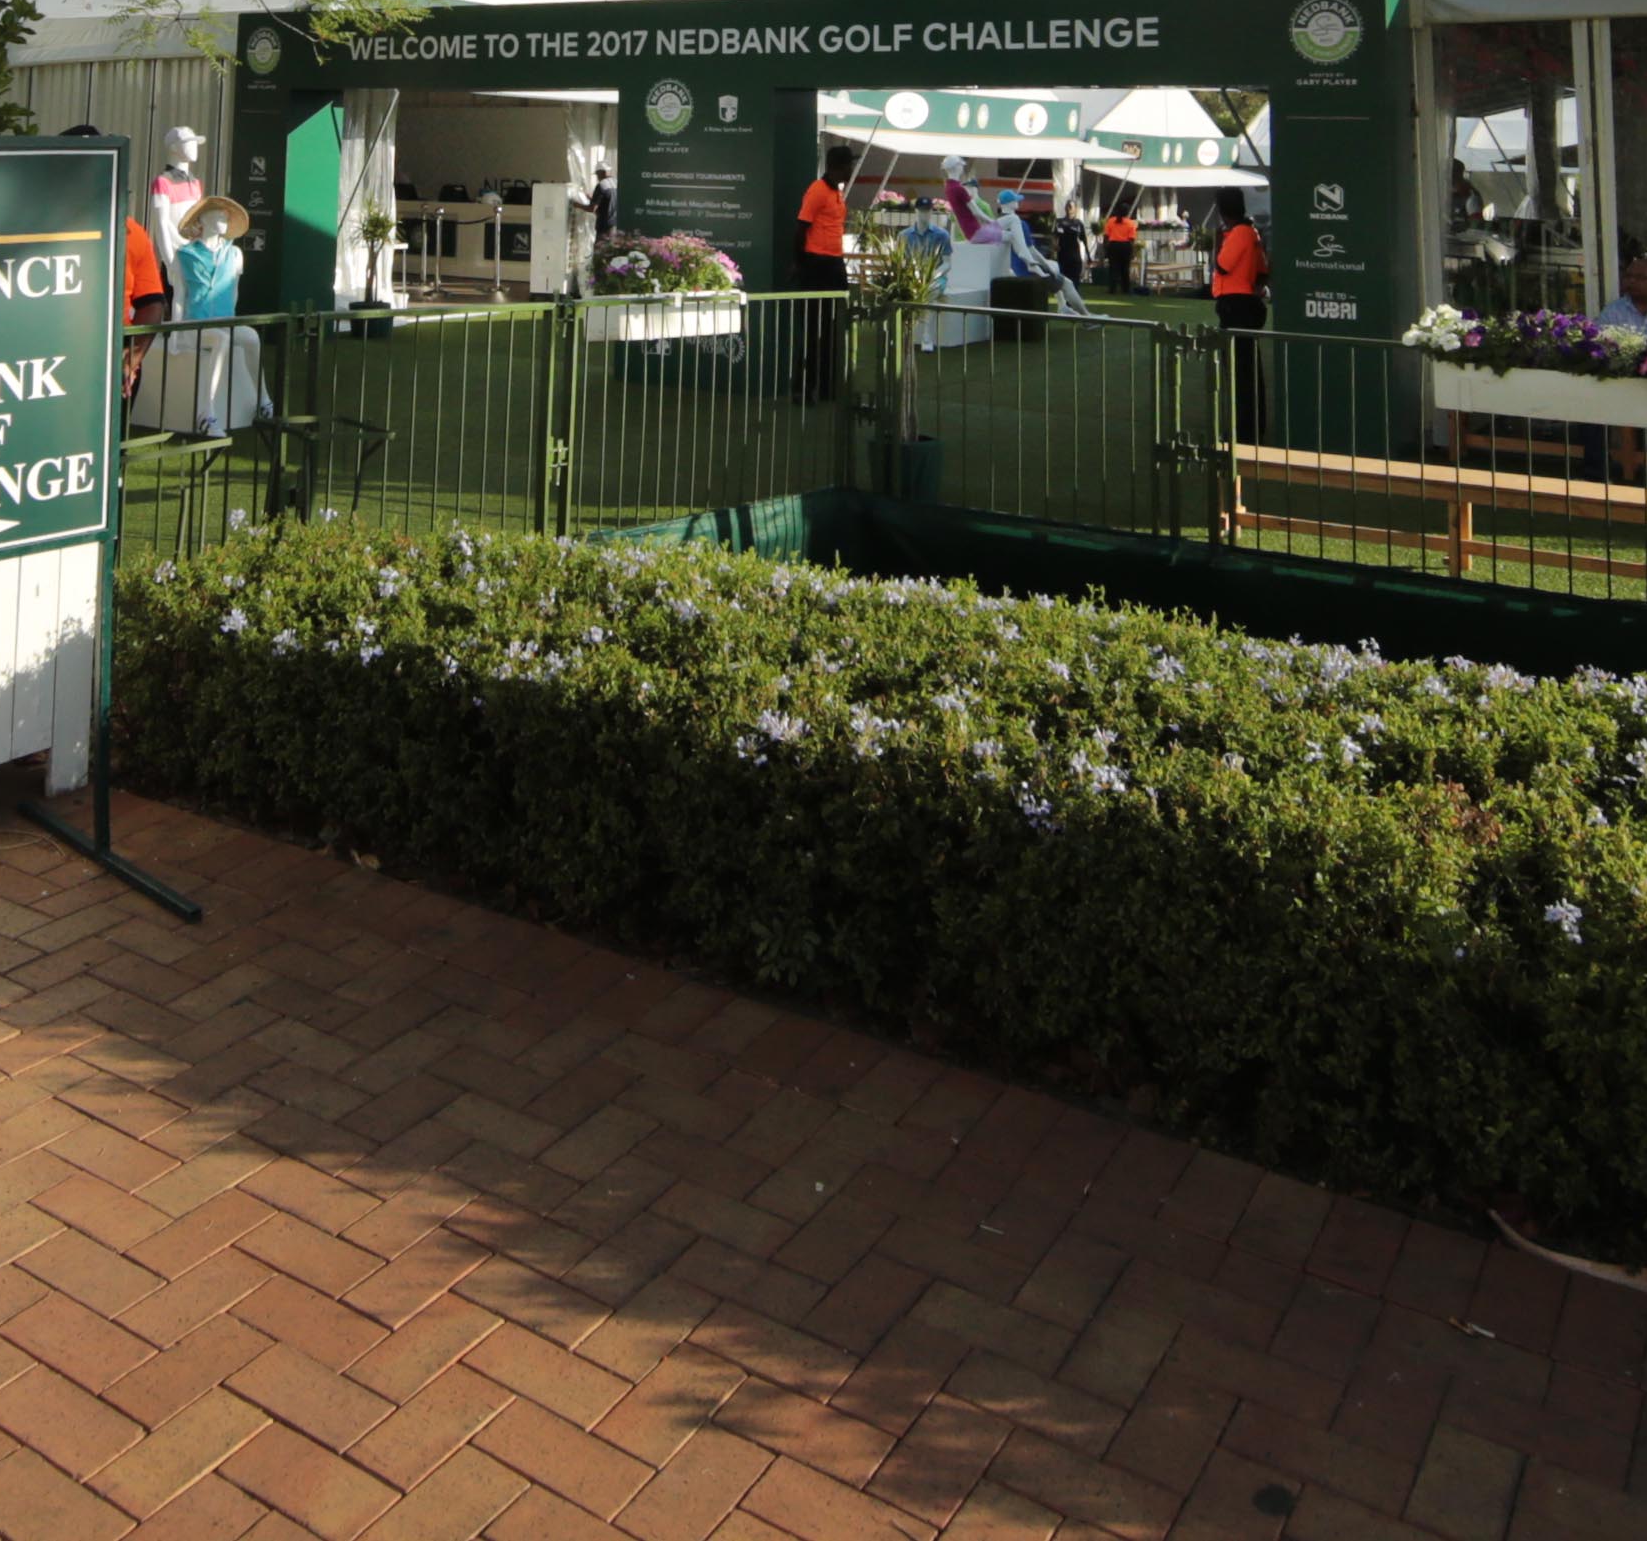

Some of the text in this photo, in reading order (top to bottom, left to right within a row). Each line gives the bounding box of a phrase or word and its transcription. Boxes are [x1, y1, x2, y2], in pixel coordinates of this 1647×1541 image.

[1297, 1, 1355, 26] NEDBANK
[349, 16, 1160, 60] WELCOME TO THE 2017 NEDBANK GOLF CHALLENGE
[650, 83, 688, 105] NEDBANK
[1295, 259, 1365, 271] International
